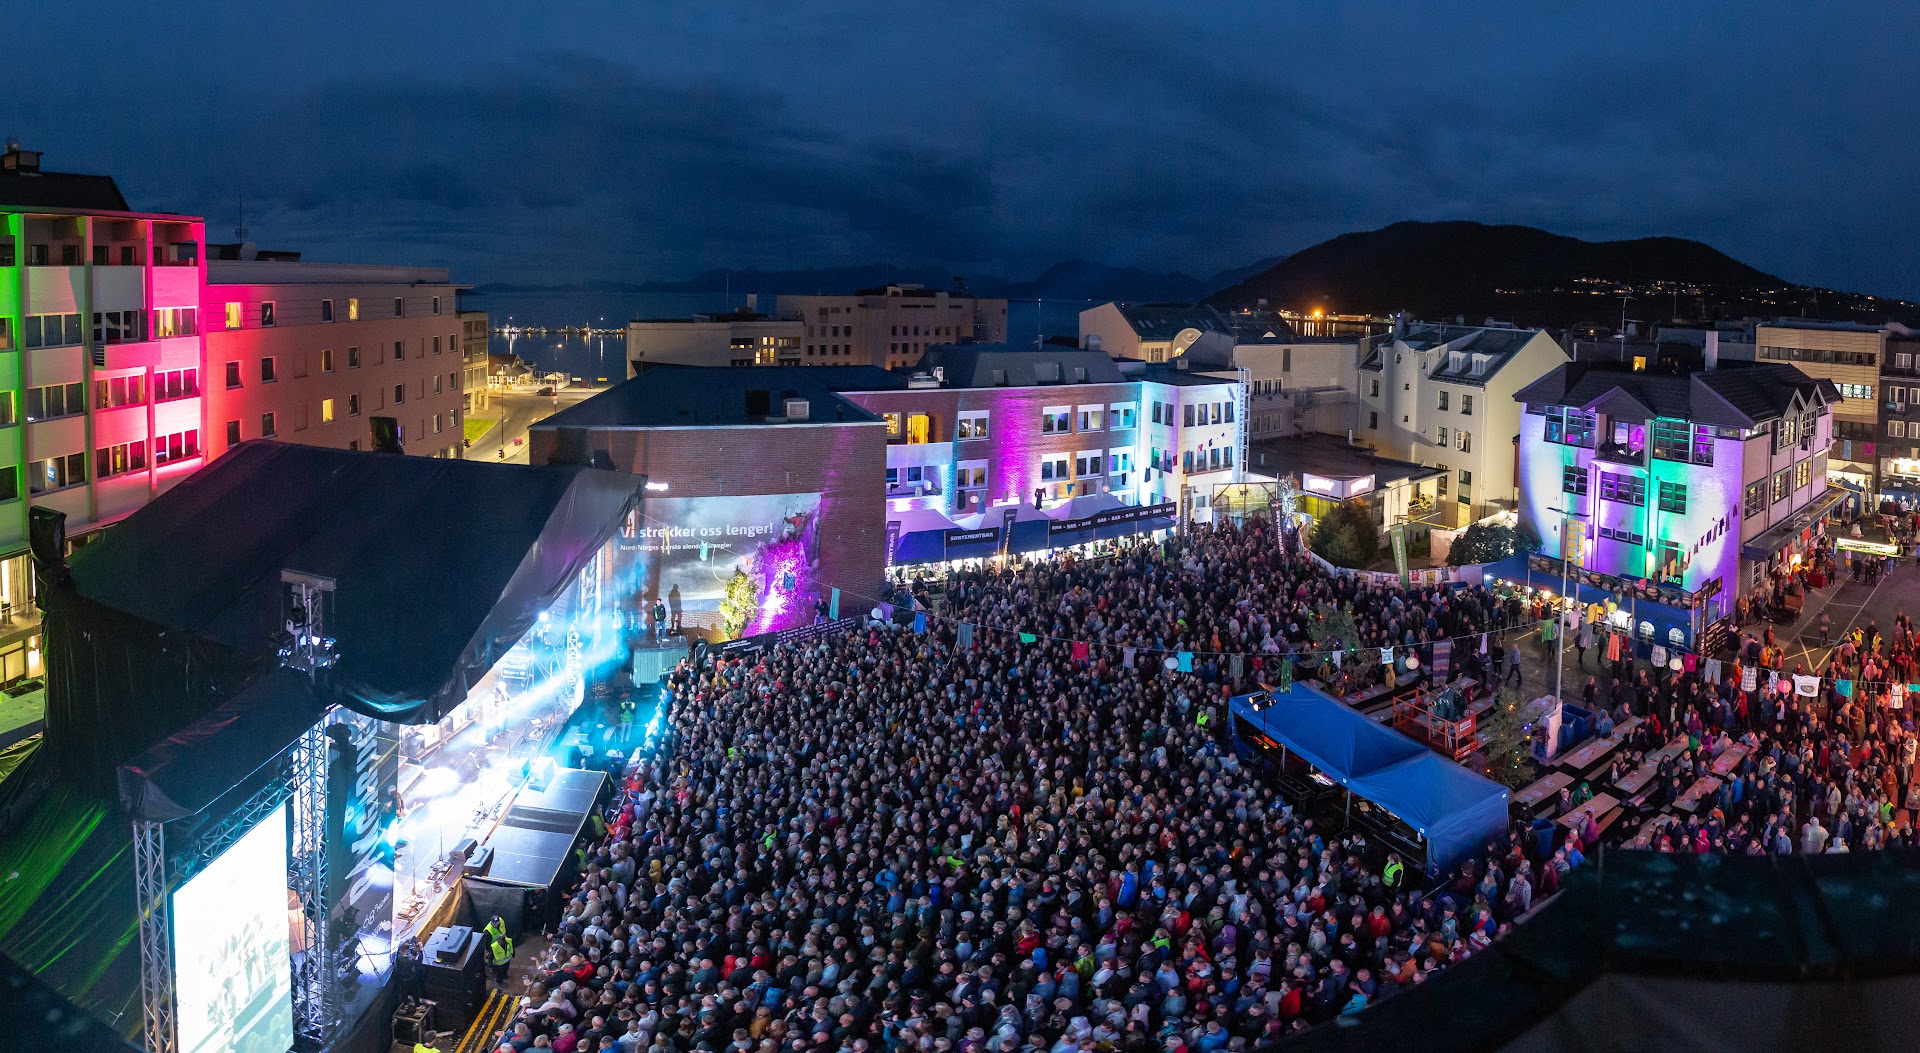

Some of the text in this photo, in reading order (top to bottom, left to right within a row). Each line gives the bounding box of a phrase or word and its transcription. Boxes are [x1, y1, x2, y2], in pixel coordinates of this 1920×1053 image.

[620, 526, 635, 538] Vi
[699, 526, 722, 537] oss
[726, 522, 773, 538] lenger!
[620, 543, 660, 552] Nord-Norges
[682, 542, 732, 550] eiendosmegler
[885, 533, 895, 583] ORTIMENTBAR
[1659, 574, 1681, 585] iRIVE
